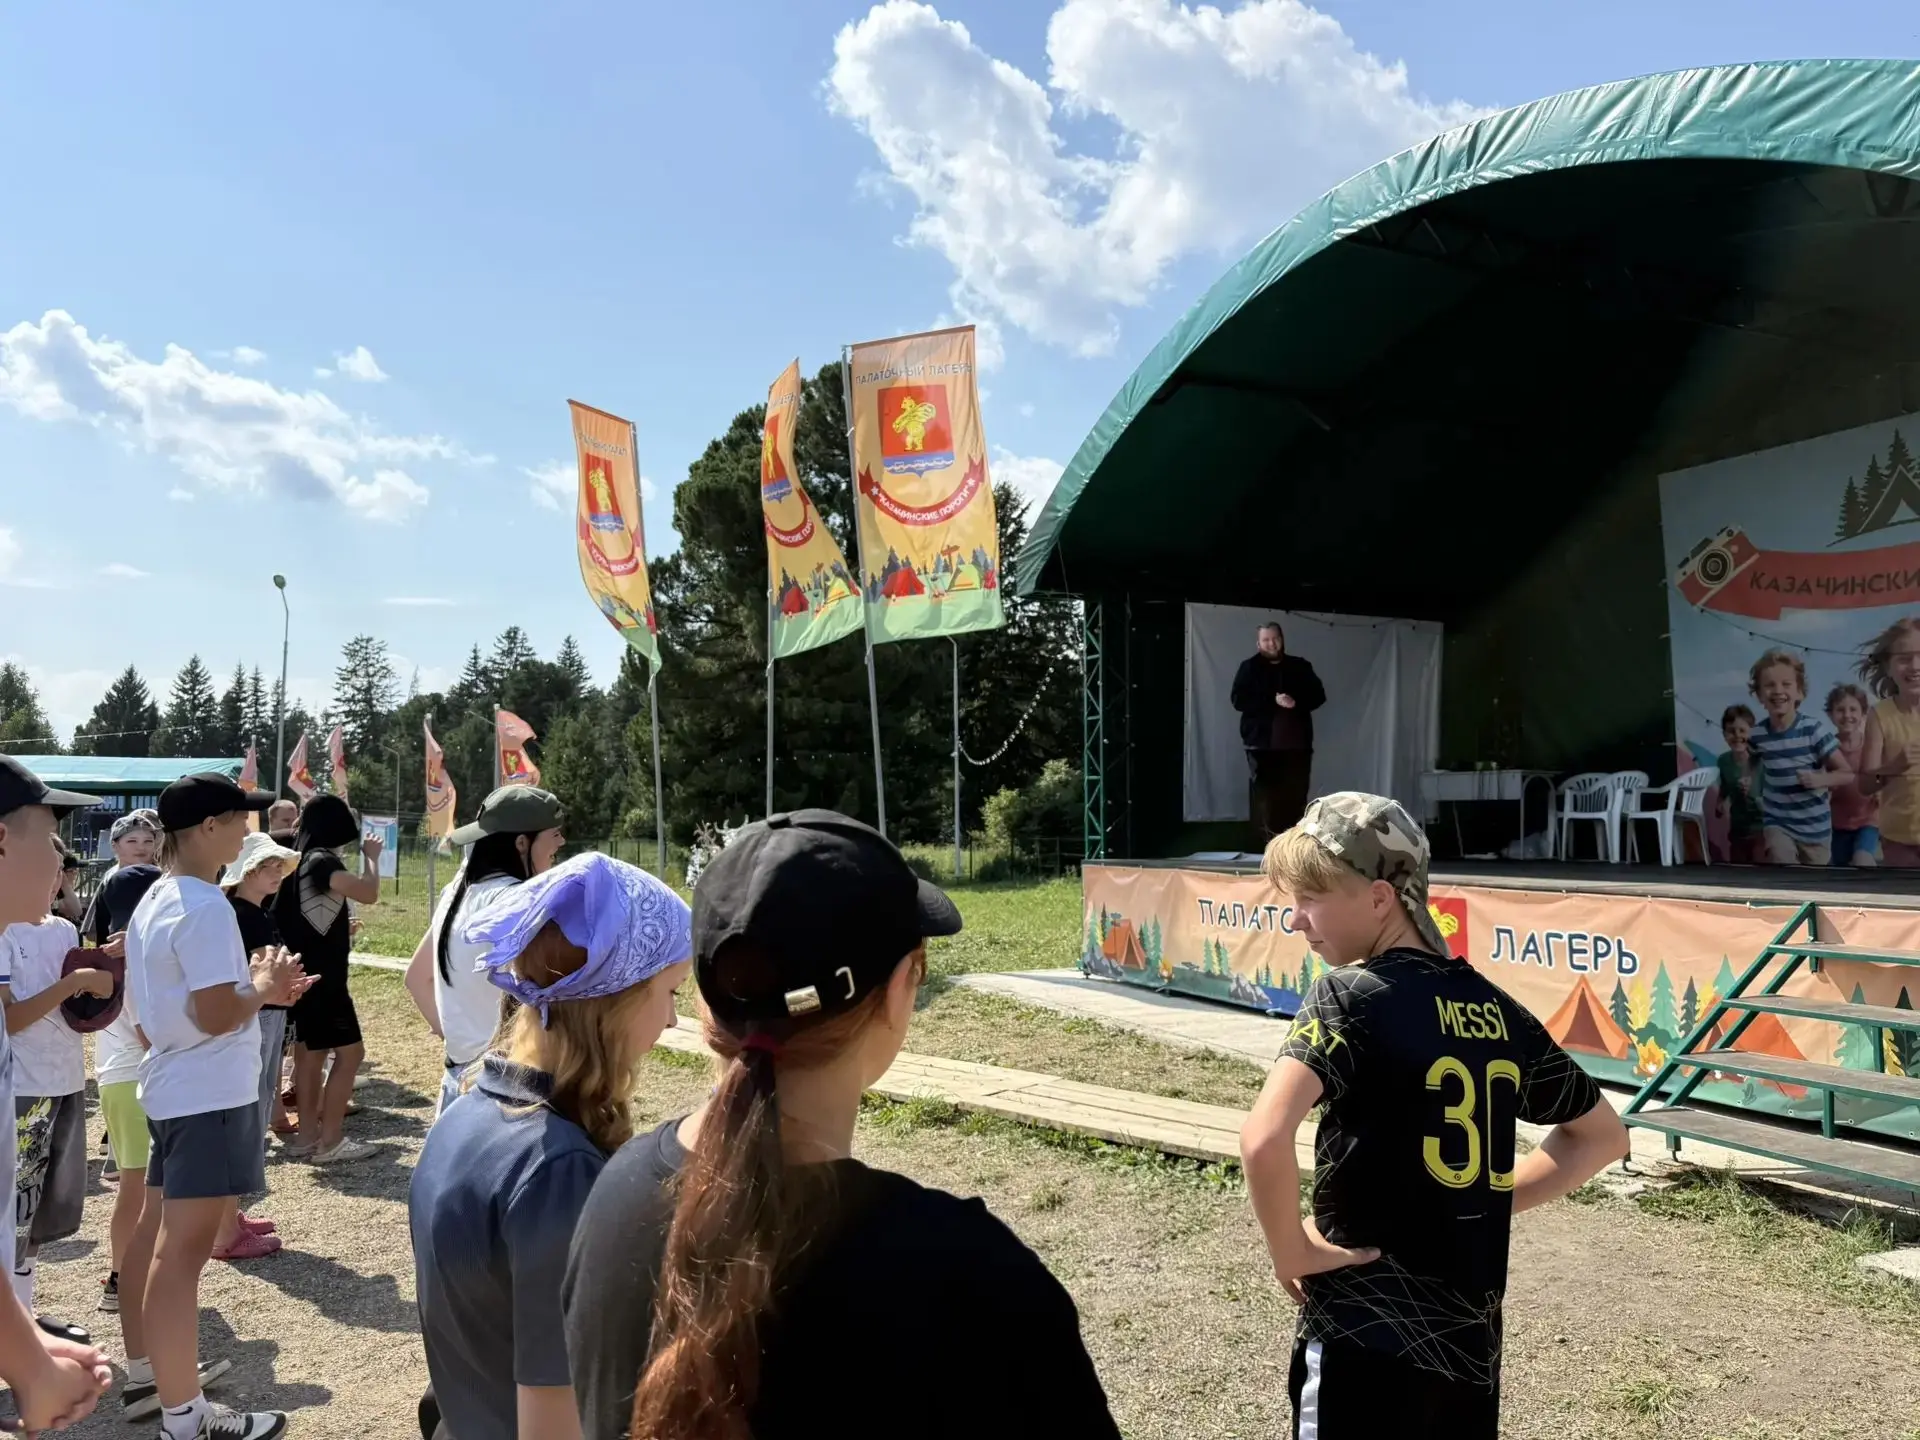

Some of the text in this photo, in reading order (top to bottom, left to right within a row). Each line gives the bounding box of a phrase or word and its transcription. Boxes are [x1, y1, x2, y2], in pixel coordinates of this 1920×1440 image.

[855, 363, 973, 384] ПАЛАТОЧНЫЙ ЛАГЕРЬ
[1750, 568, 1920, 596] КАЗАЧИНСКИ
[1491, 926, 1640, 976] ЛАГЕРЬ
[1422, 1055, 1521, 1192] 30
